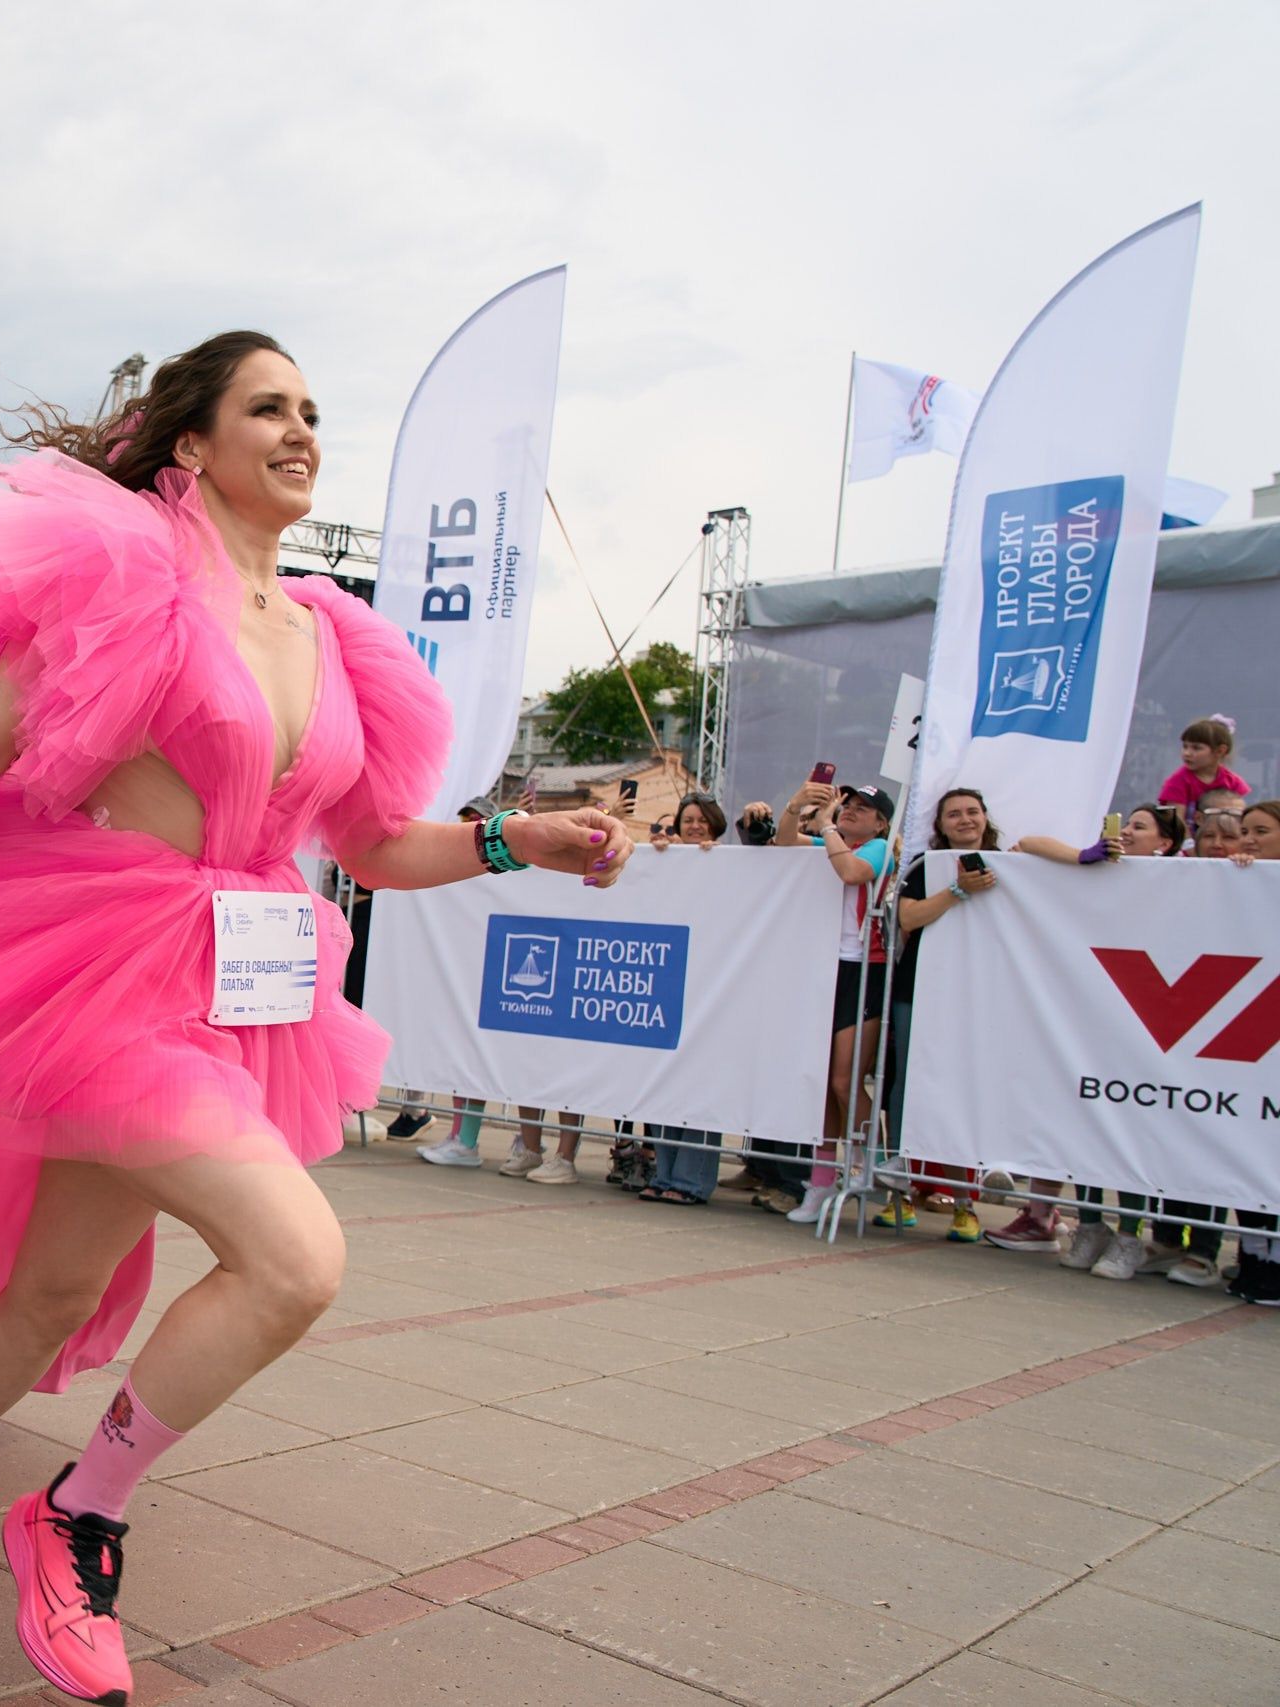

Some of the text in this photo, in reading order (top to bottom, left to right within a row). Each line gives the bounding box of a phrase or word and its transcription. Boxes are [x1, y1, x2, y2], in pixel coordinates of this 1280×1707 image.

[421, 498, 477, 621] ВТБ
[486, 491, 507, 619] Официальный
[996, 511, 1025, 628] ПРОЕКТ
[1064, 498, 1100, 622] ГОРОДА
[502, 545, 521, 618] партнер
[1027, 522, 1059, 626] ГЛАВЫ
[297, 908, 314, 936] 722
[221, 960, 293, 975] ЗАБЕГ В СВАДЕБНЫХ
[576, 937, 671, 966] ПРОЕКТ
[221, 978, 254, 991] ПЛАТЬЯХ
[573, 967, 654, 996] ГЛАВЫ
[499, 1001, 553, 1016] ТЮМЕНЬ
[570, 996, 666, 1029] ГОРОДА
[1080, 1076, 1239, 1117] ВОСТОК
